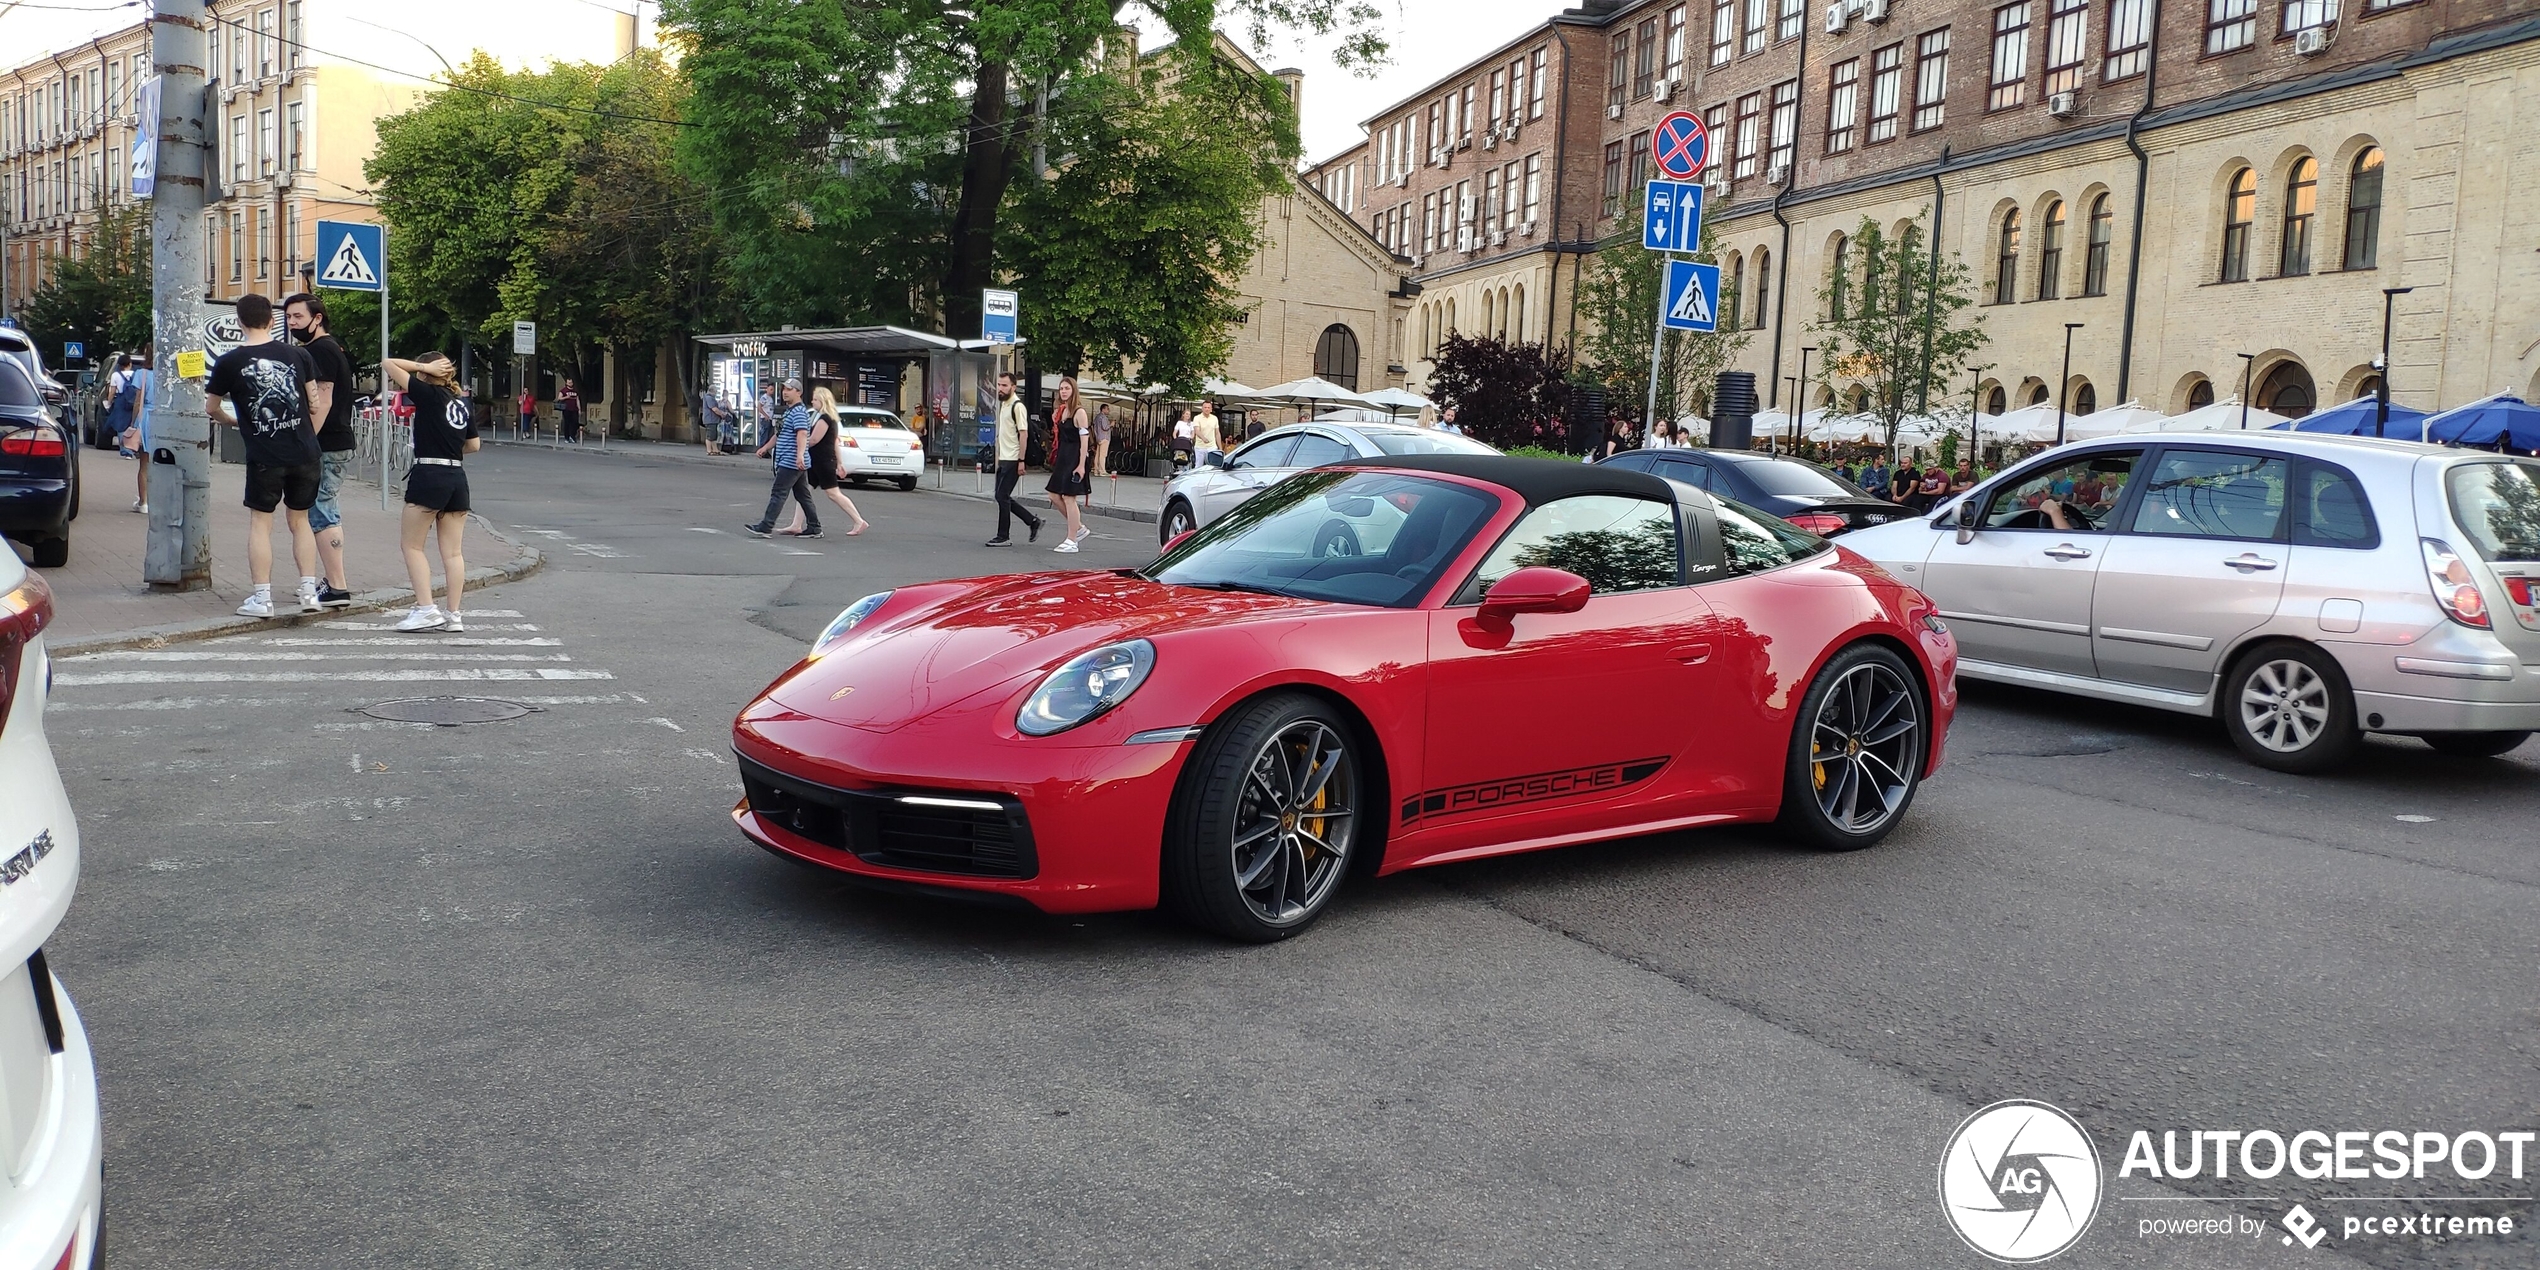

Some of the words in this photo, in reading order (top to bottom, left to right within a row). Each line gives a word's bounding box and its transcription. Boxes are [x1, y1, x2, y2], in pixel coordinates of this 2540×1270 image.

[733, 341, 768, 357] traffic
[252, 420, 269, 435] The
[1692, 564, 1717, 573] targa
[1452, 768, 1616, 808] PORSCHE
